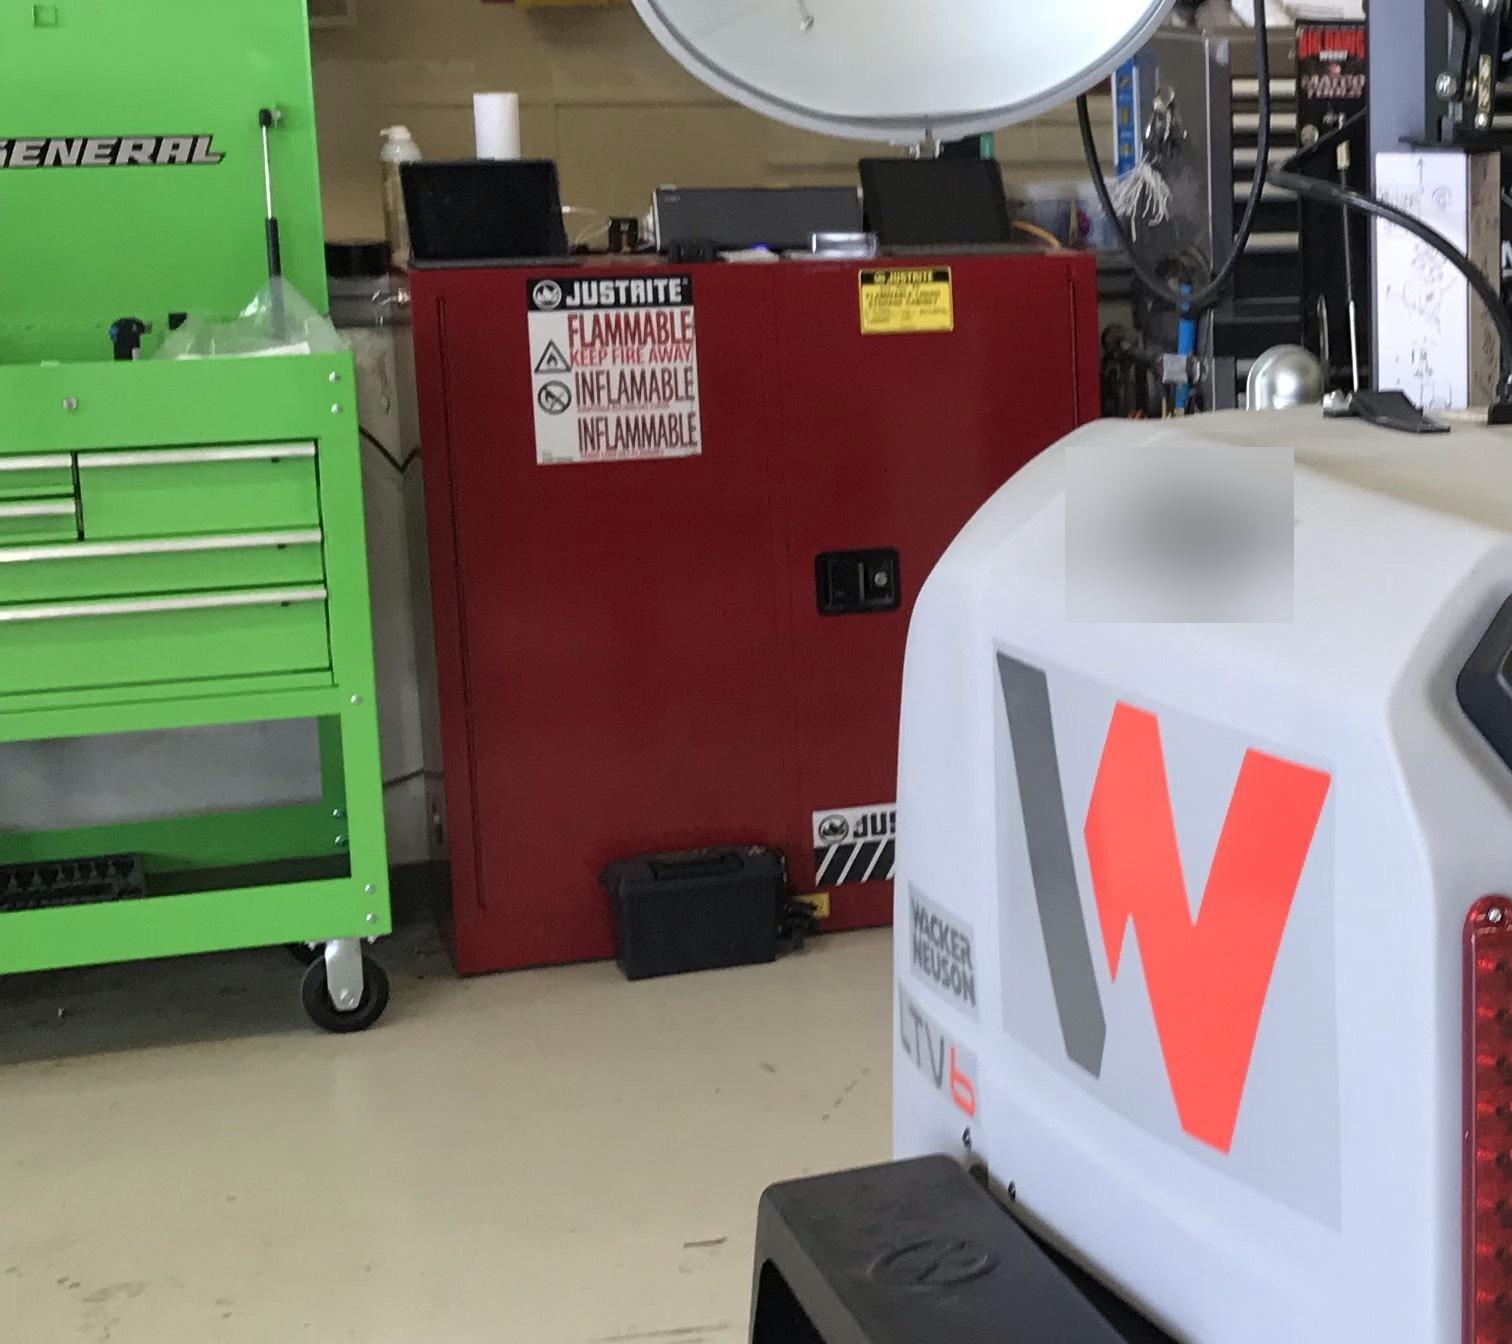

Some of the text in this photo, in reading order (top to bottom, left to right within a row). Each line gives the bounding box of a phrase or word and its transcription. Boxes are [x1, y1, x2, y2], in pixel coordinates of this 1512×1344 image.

[0, 136, 224, 167] ENERAL
[565, 278, 682, 306] JUSTRITE
[567, 310, 695, 348] FLAMMABLE
[570, 343, 693, 366] KEEP FIRE AWAY
[575, 367, 695, 406] INFLAMABLE
[578, 412, 698, 452] INFLAMMABLE
